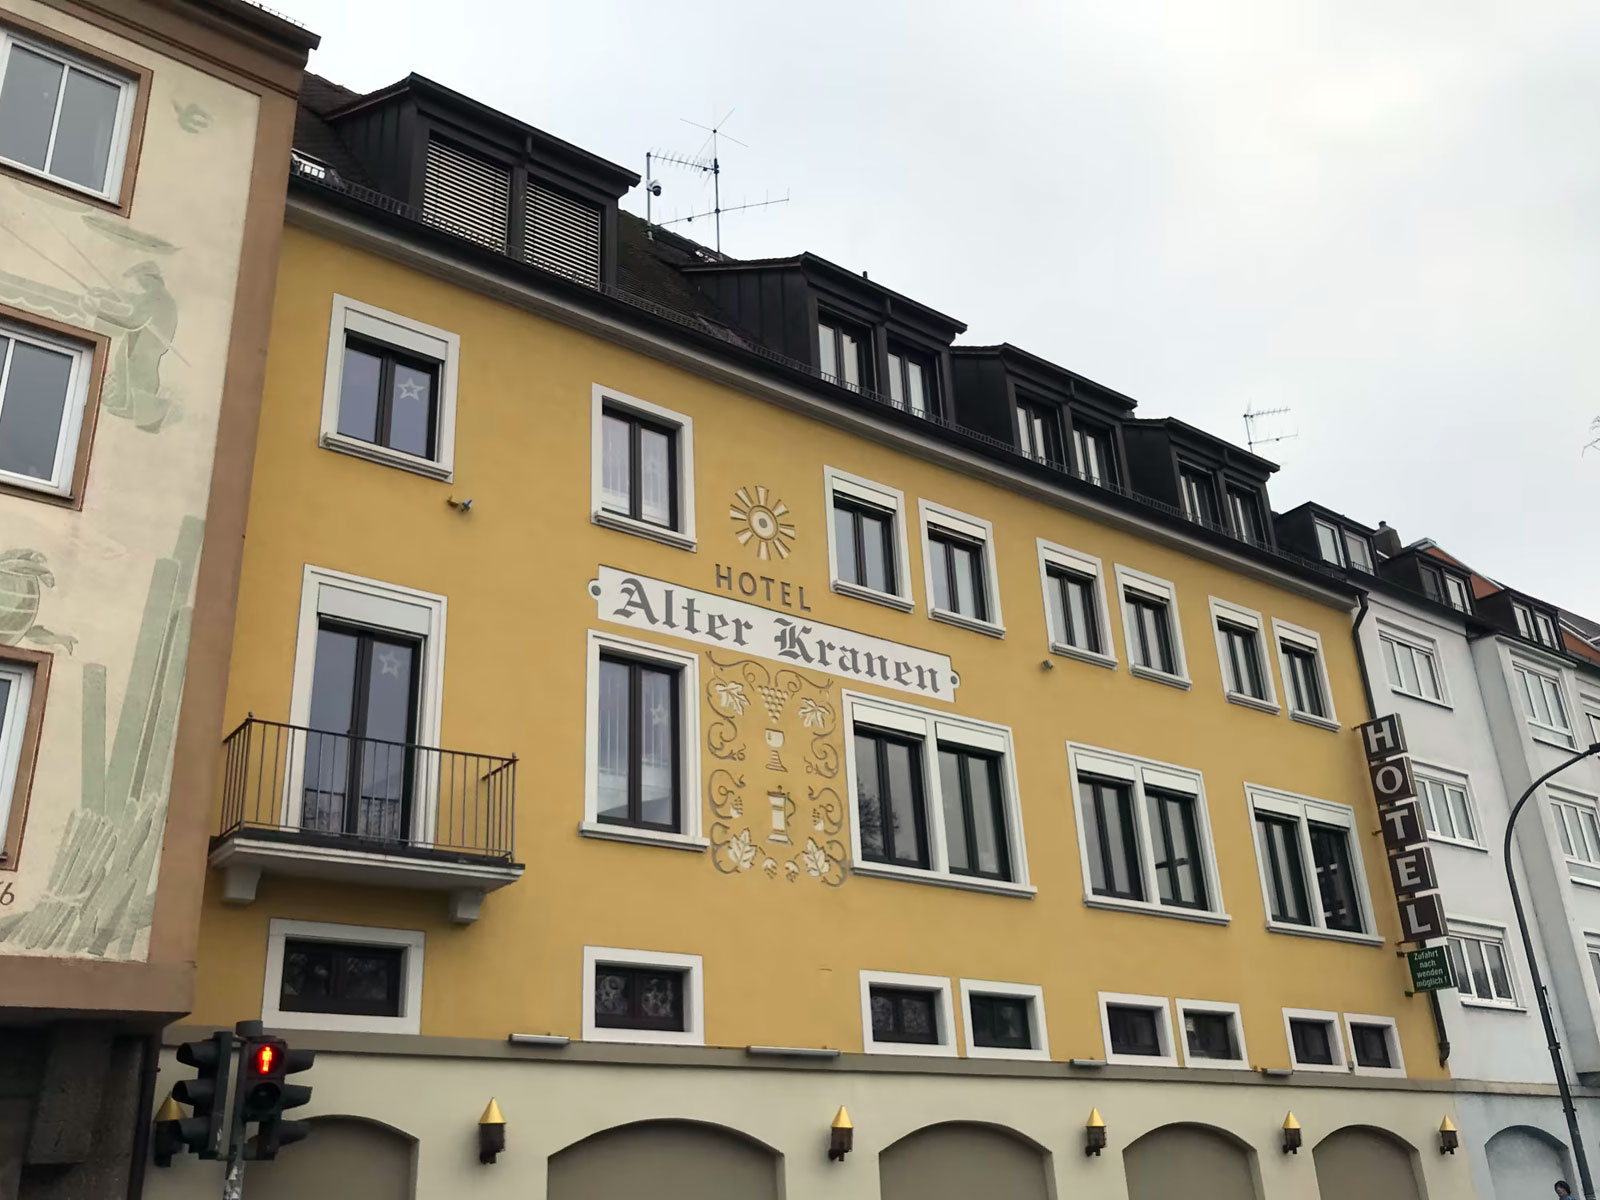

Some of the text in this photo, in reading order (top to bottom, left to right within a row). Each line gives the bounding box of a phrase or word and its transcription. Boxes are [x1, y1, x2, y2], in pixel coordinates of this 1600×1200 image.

[715, 563, 811, 612] HOTEL
[612, 577, 941, 694] Alter Kranen
[1366, 720, 1431, 935] HOTEL
[0, 881, 15, 906] 6
[1414, 950, 1438, 960] Zufahrt
[1420, 960, 1436, 968] nach
[1416, 968, 1443, 978] wenden
